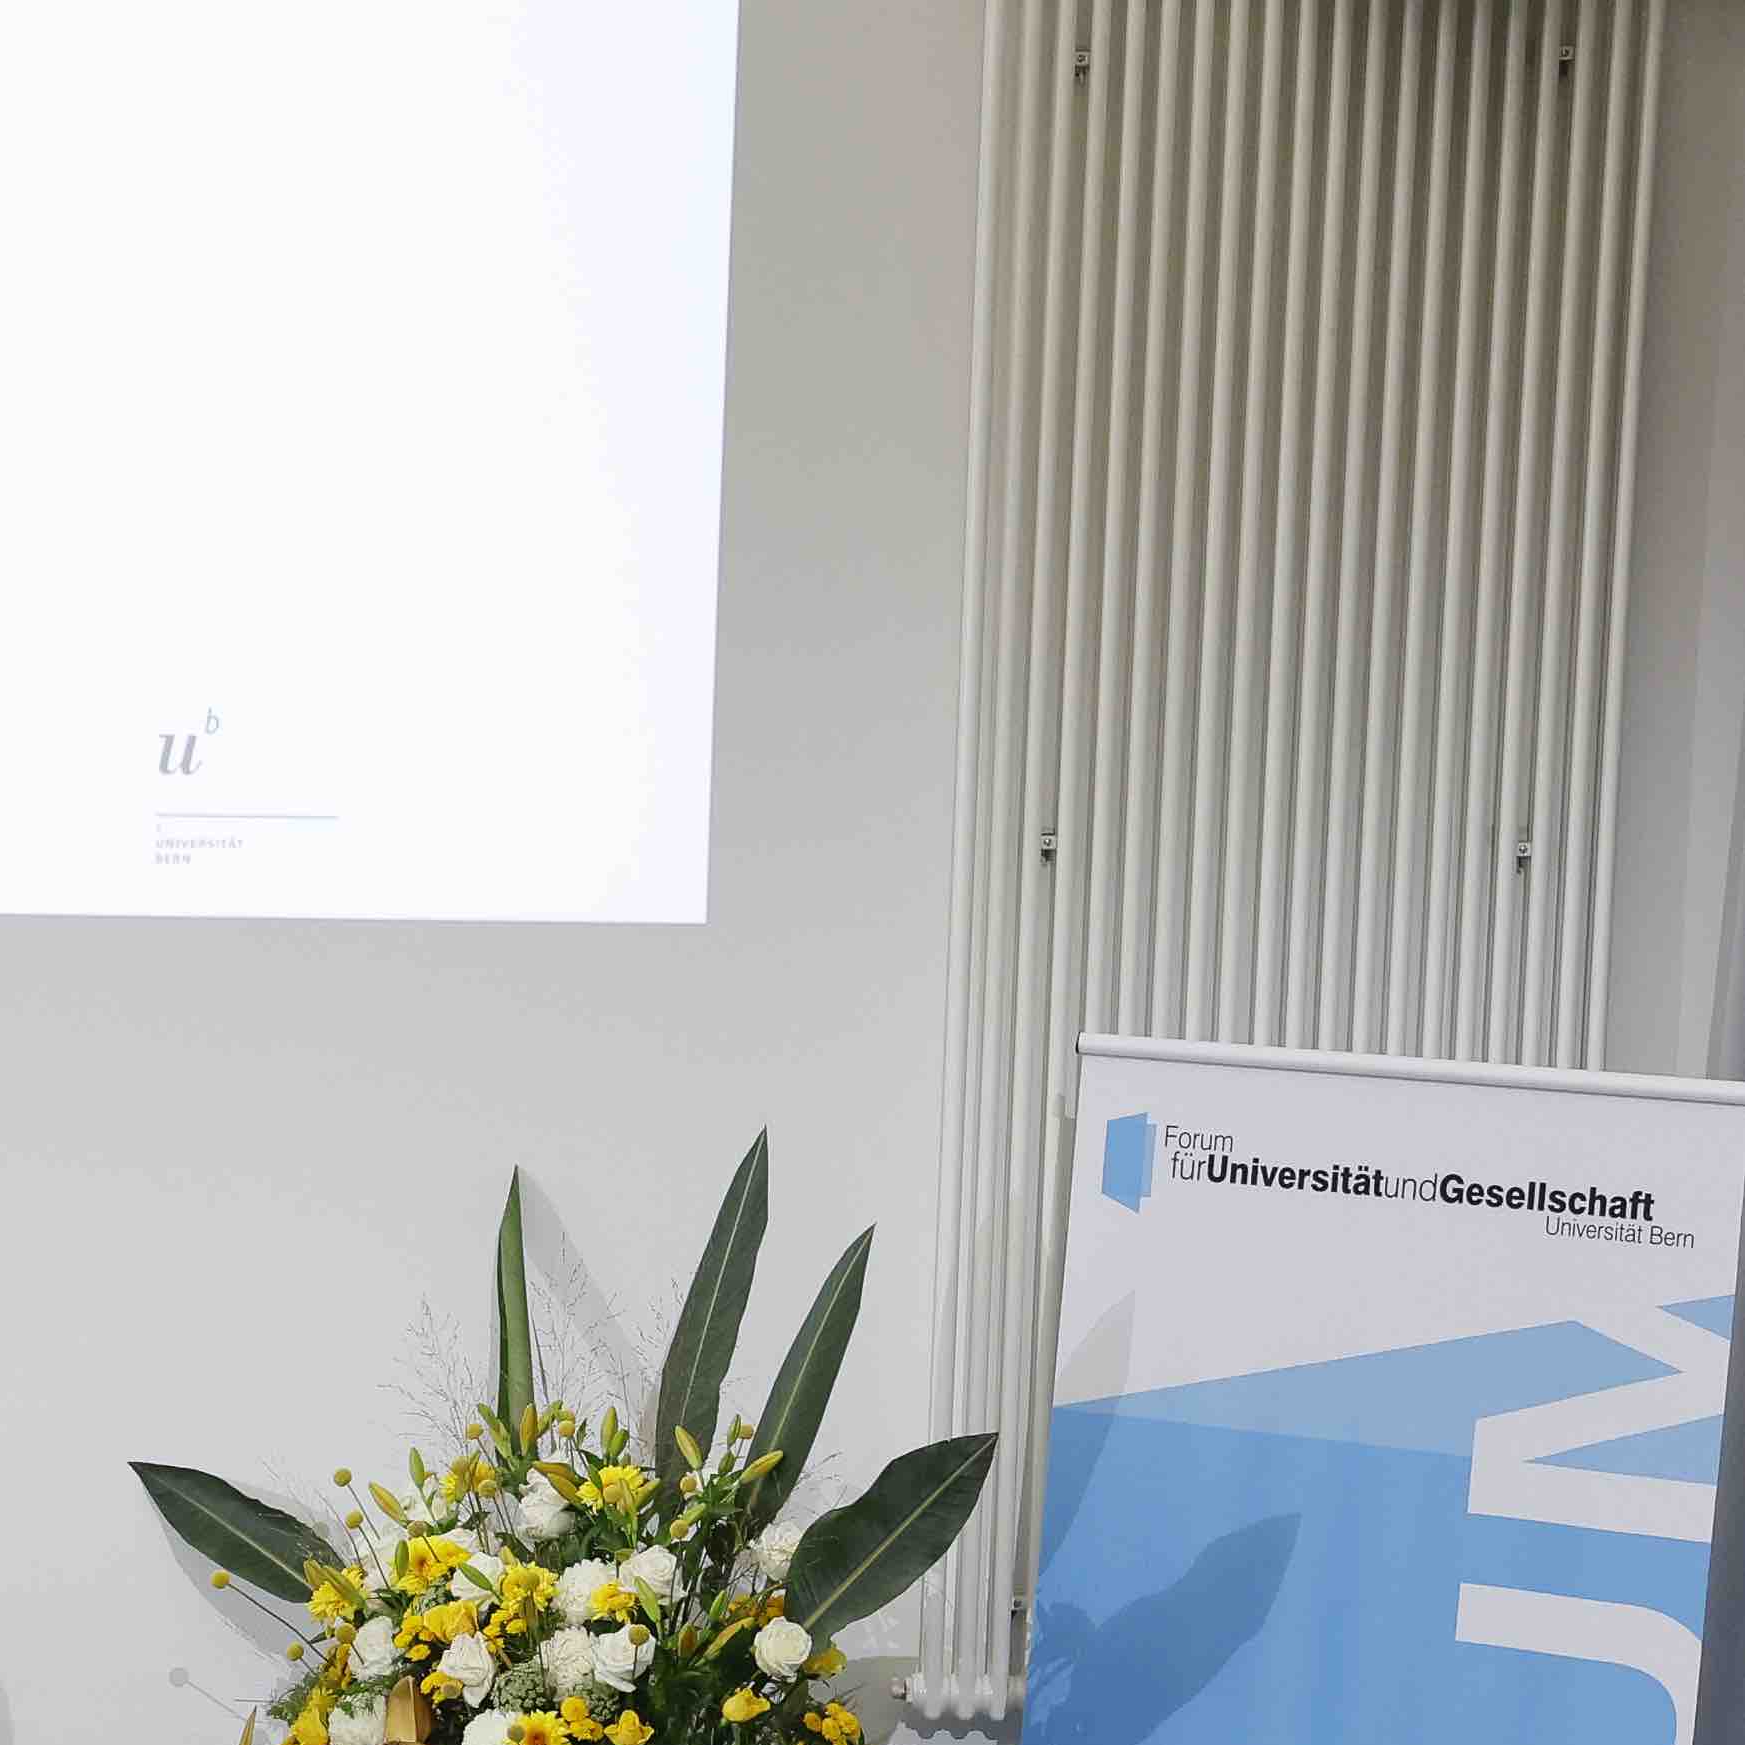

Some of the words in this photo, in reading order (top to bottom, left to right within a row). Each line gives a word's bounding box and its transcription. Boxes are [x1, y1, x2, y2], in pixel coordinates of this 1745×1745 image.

[1164, 1125, 1234, 1152] Forum
[1545, 1215, 1642, 1244] Universität
[1649, 1226, 1695, 1248] Bern
